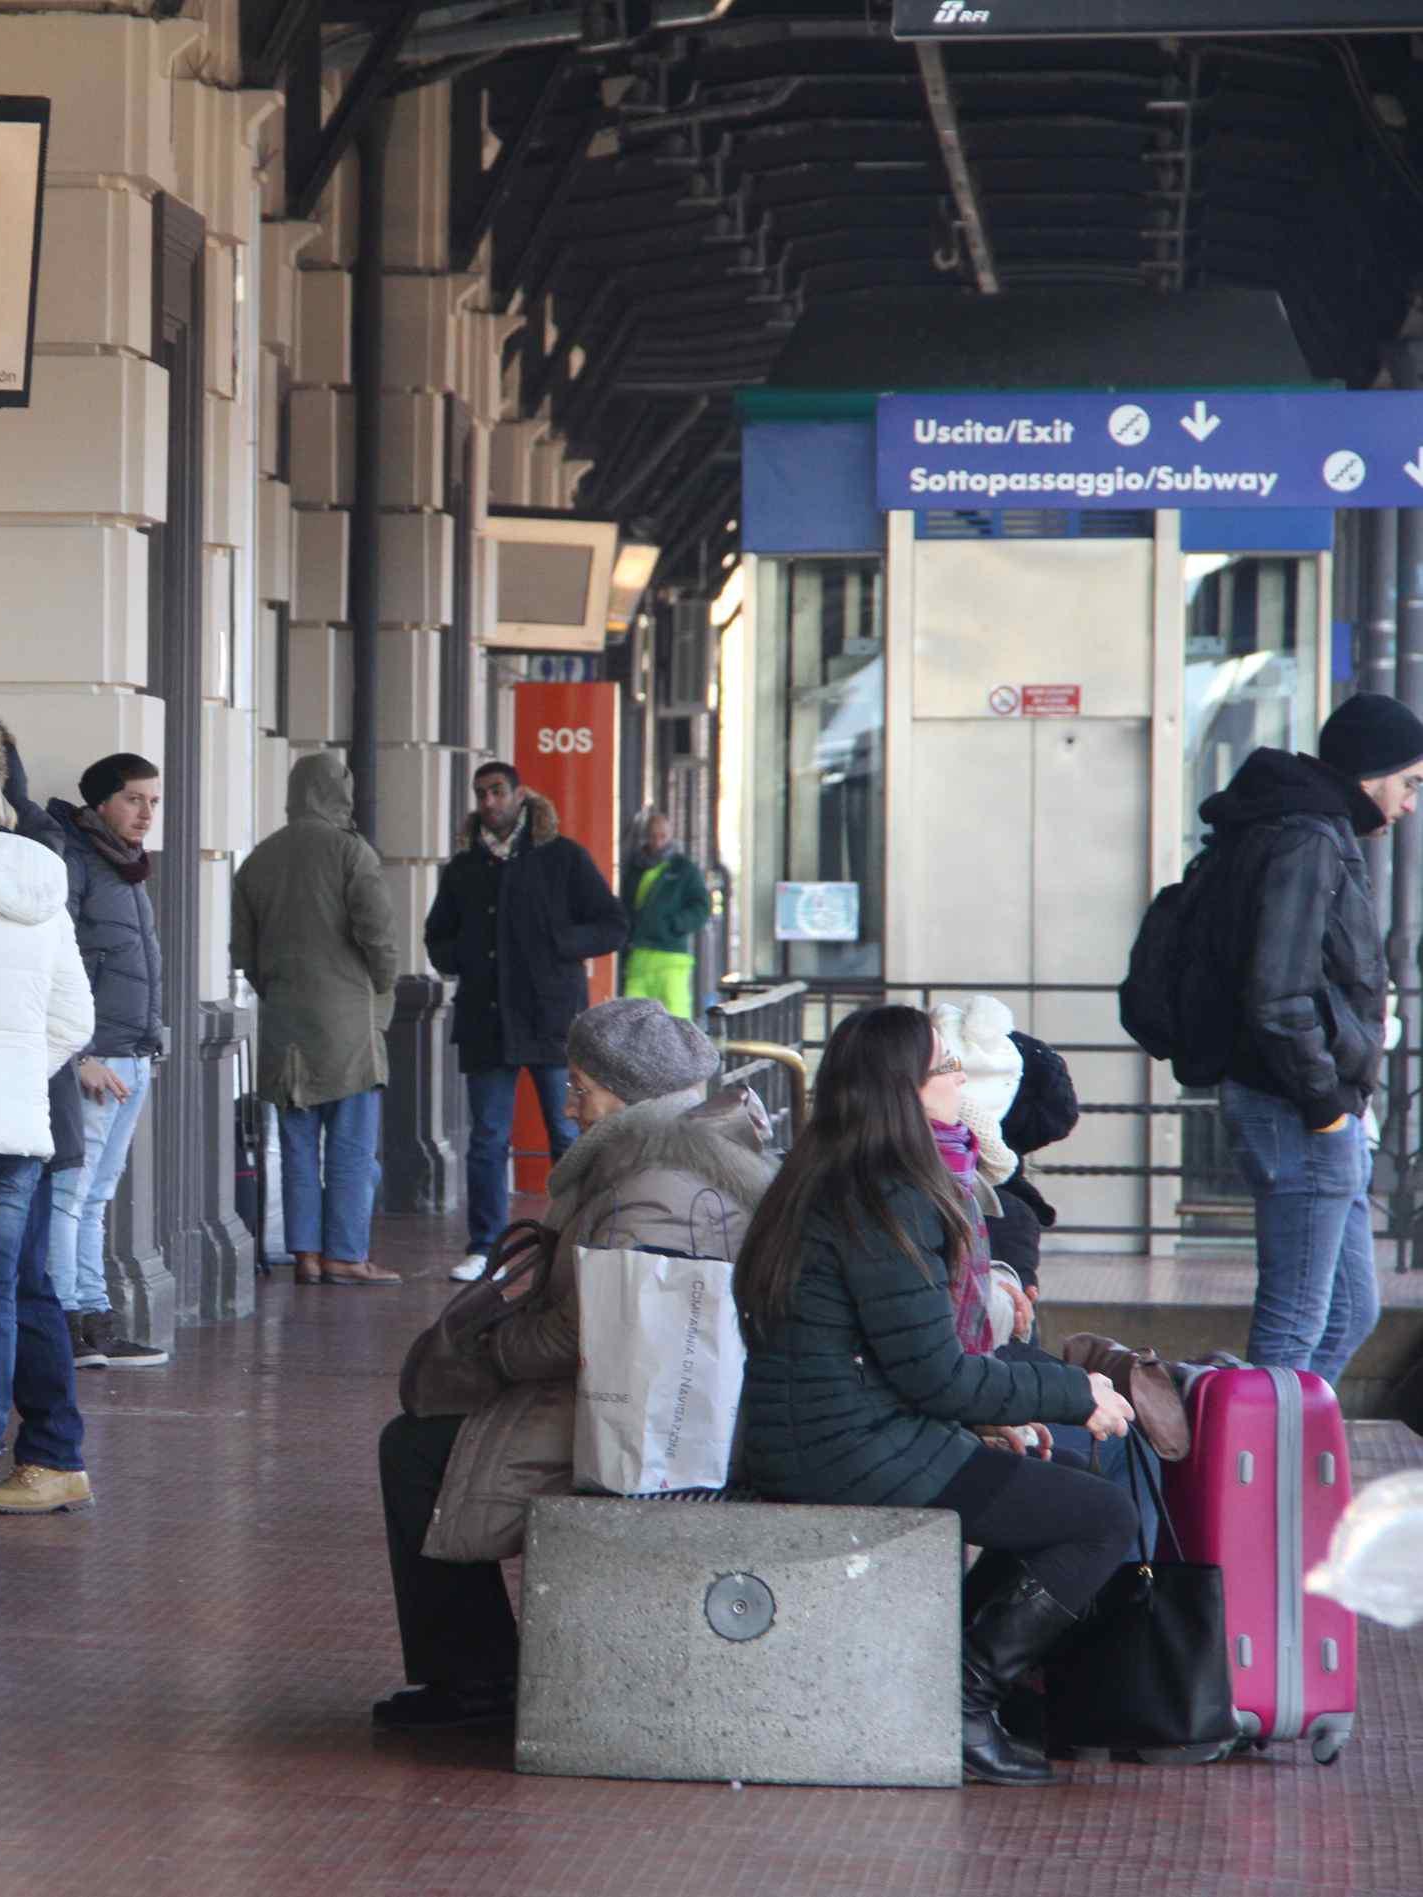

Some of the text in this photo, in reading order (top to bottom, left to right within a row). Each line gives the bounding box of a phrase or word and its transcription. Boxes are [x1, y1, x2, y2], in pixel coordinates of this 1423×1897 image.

[959, 10, 990, 23] RFI
[913, 419, 1075, 444] Uscita/Exit
[910, 466, 1278, 498] Sottopassaggio/Subway
[538, 727, 593, 754] SOS
